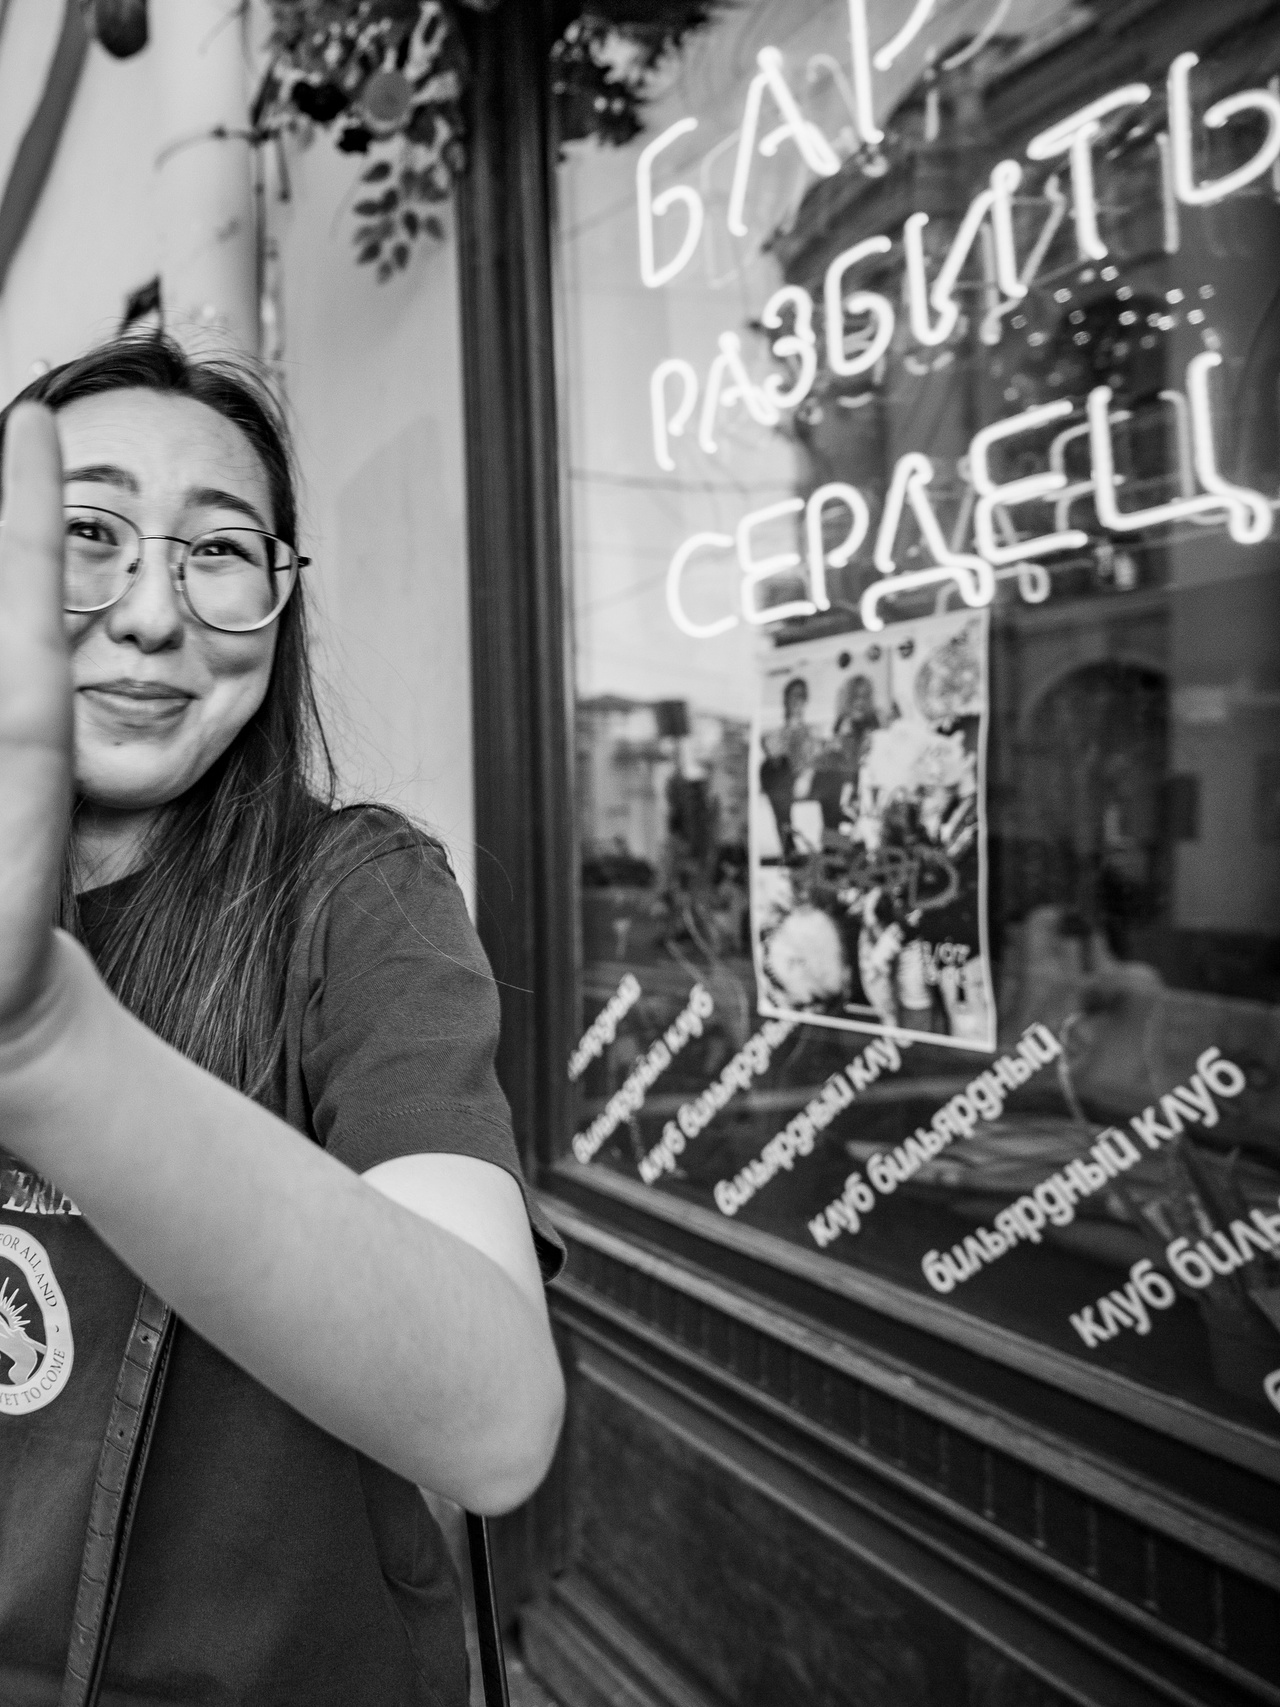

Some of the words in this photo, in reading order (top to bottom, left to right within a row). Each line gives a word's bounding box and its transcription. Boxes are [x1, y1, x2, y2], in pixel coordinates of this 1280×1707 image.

[666, 350, 1273, 640] СЕРДЕЦ
[638, 1120, 686, 1184] клуб
[677, 1019, 802, 1139] бильярдны
[713, 1071, 855, 1216] бильярдный
[845, 1036, 914, 1091] клу
[808, 1171, 875, 1248] клуб
[867, 1021, 1062, 1194] бильярдный
[921, 1127, 1141, 1294] бильярдный
[1130, 1046, 1246, 1149] клуб
[19, 1246, 42, 1273] ALL
[35, 1272, 58, 1308] AND
[1069, 1257, 1176, 1348] клуб
[1165, 1205, 1280, 1291] биль
[20, 1387, 42, 1404] TO
[40, 1348, 66, 1391] COME
